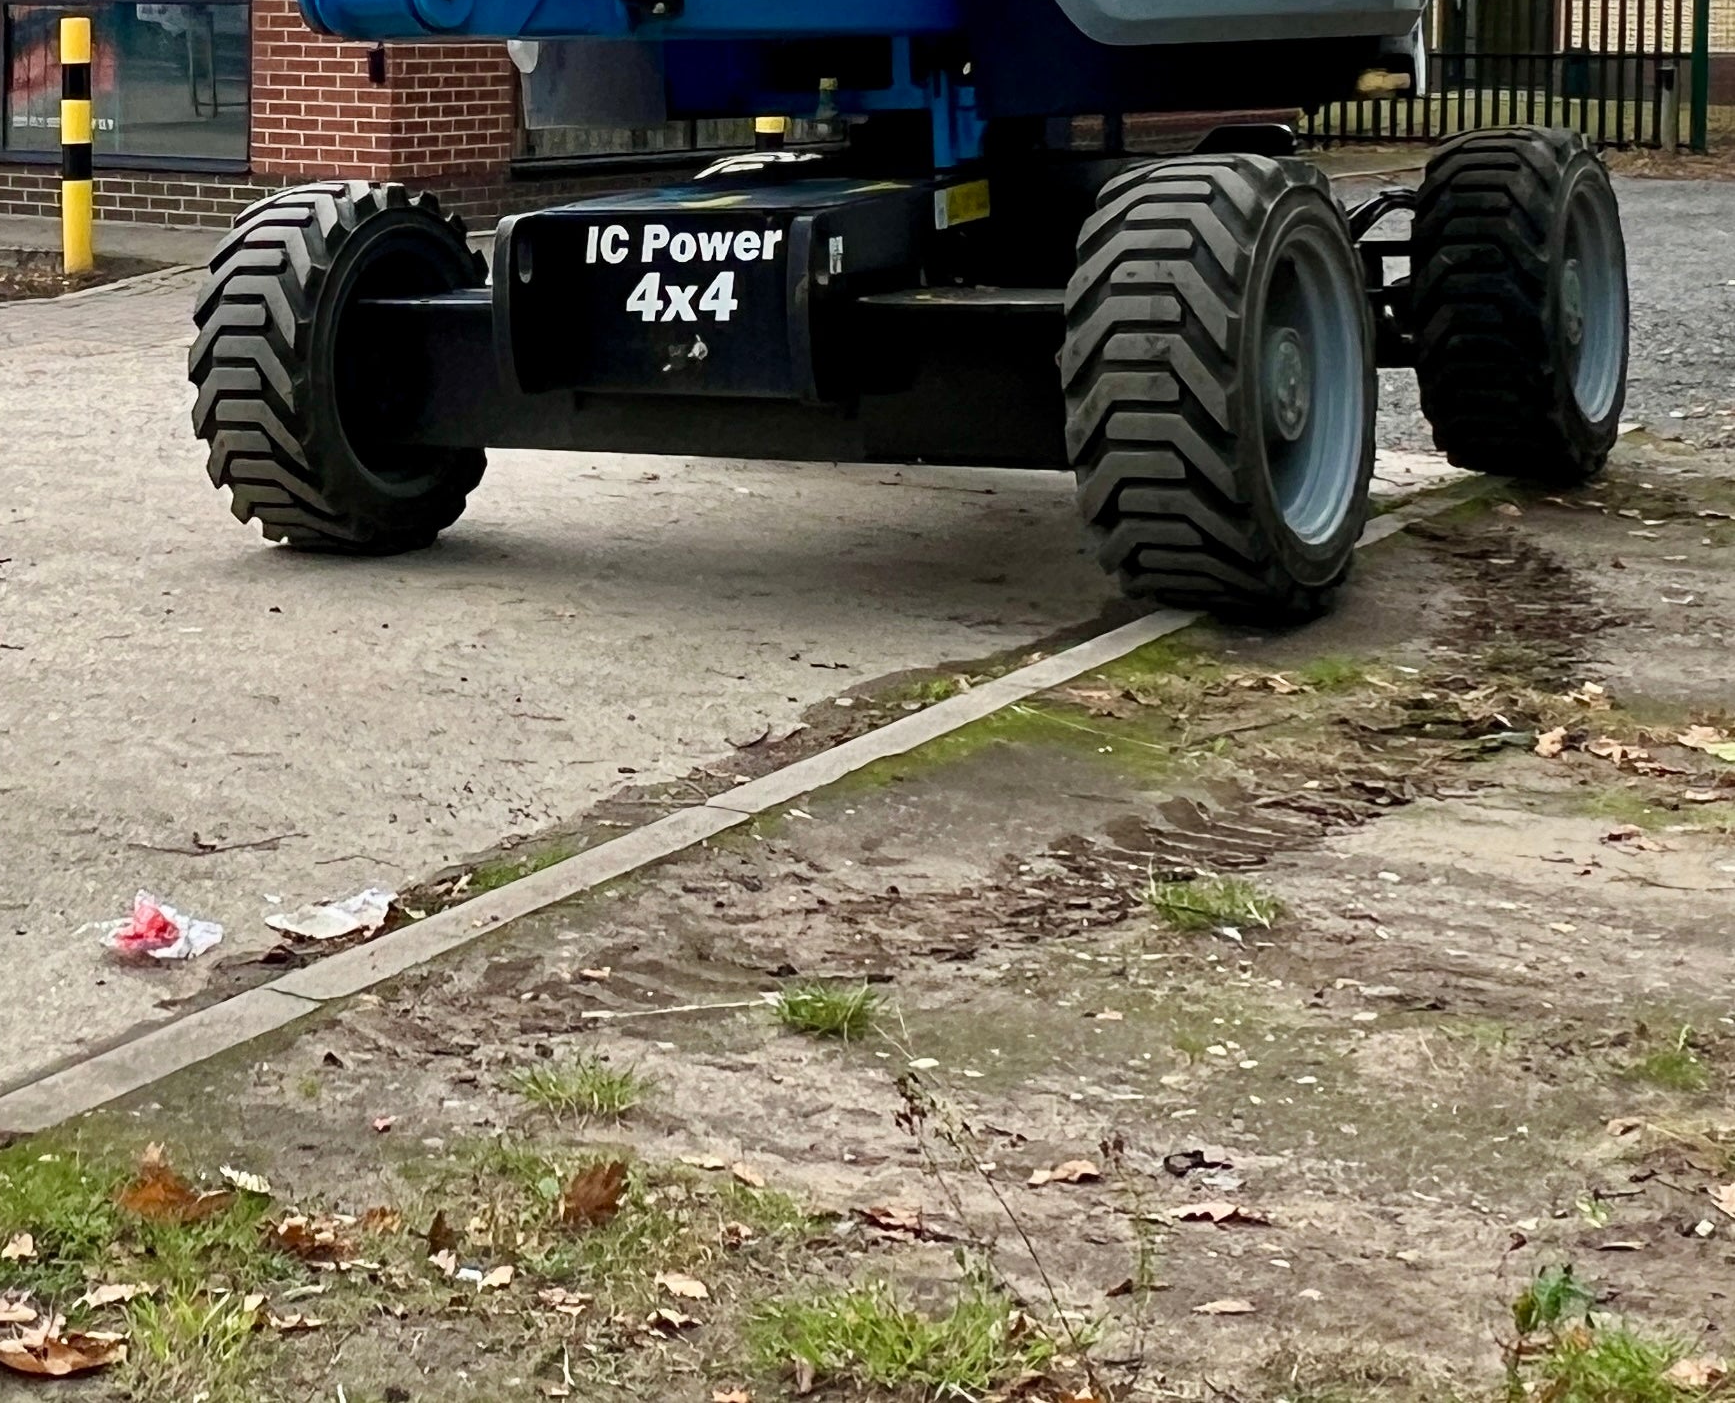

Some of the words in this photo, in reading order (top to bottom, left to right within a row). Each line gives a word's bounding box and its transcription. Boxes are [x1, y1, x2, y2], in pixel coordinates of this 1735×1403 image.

[585, 224, 630, 264] IC
[640, 224, 783, 263] Power
[626, 271, 739, 322] 4x4
